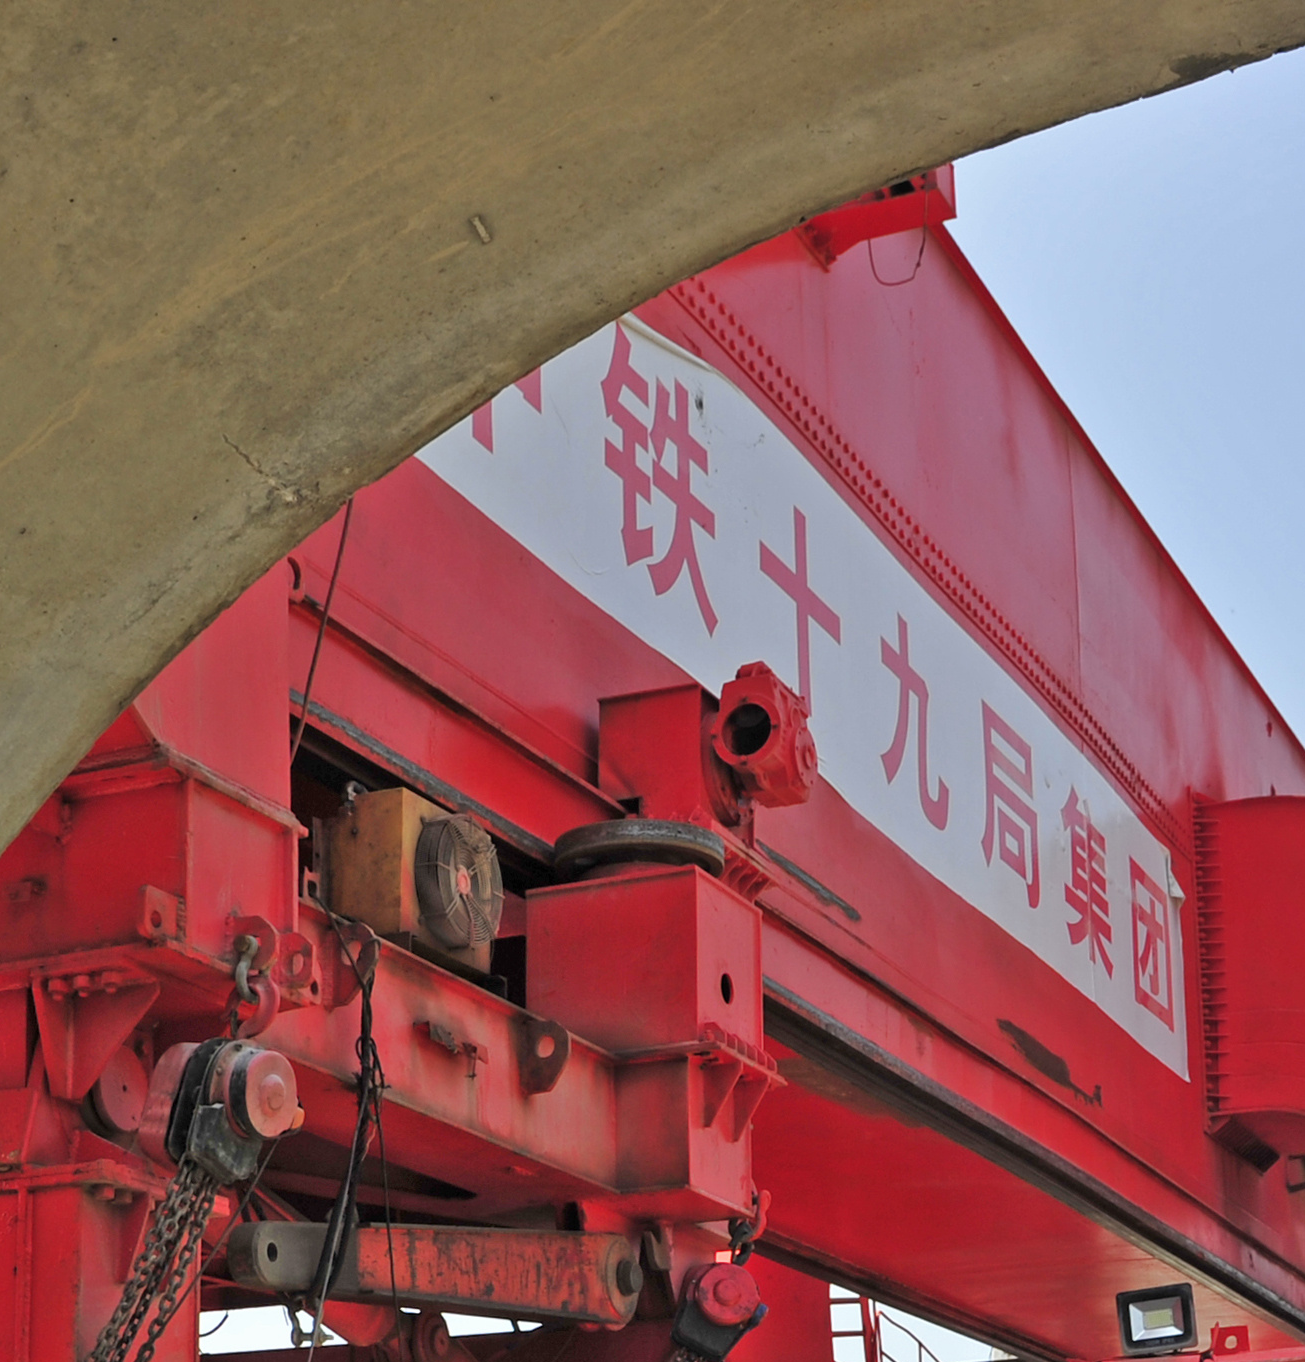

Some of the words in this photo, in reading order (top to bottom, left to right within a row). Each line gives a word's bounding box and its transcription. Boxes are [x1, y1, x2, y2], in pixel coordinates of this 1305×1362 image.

[472, 321, 1175, 1033] 铁十九局集团
